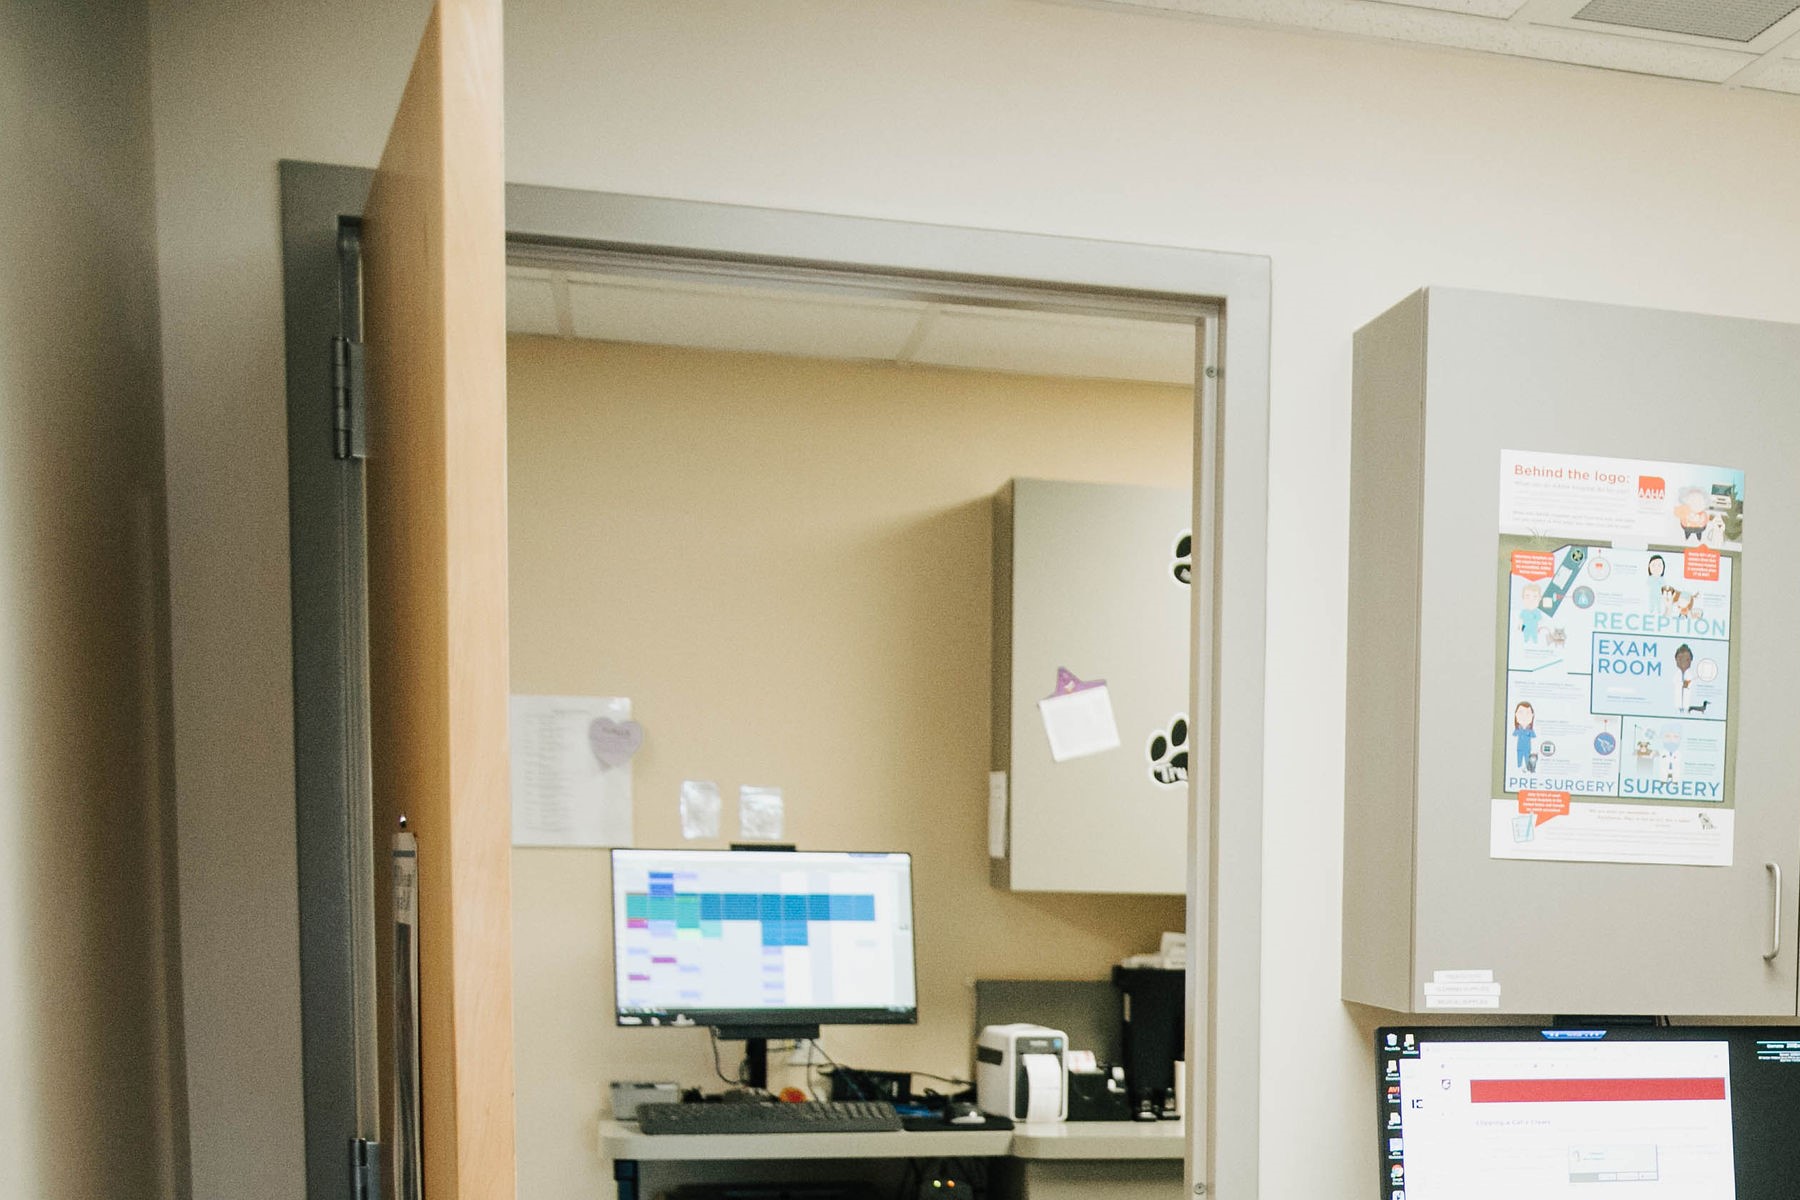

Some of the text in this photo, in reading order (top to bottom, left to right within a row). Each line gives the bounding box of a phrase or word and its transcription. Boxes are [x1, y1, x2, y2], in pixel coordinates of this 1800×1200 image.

[1514, 464, 1630, 485] Behind the logo:
[1638, 487, 1665, 499] AAHA
[1593, 612, 1727, 638] RECEPTION
[1599, 639, 1658, 658] EXAM
[1598, 658, 1662, 677] ROOM
[1509, 777, 1615, 793] PRE-SURGERY
[1623, 778, 1721, 798] SURGERY
